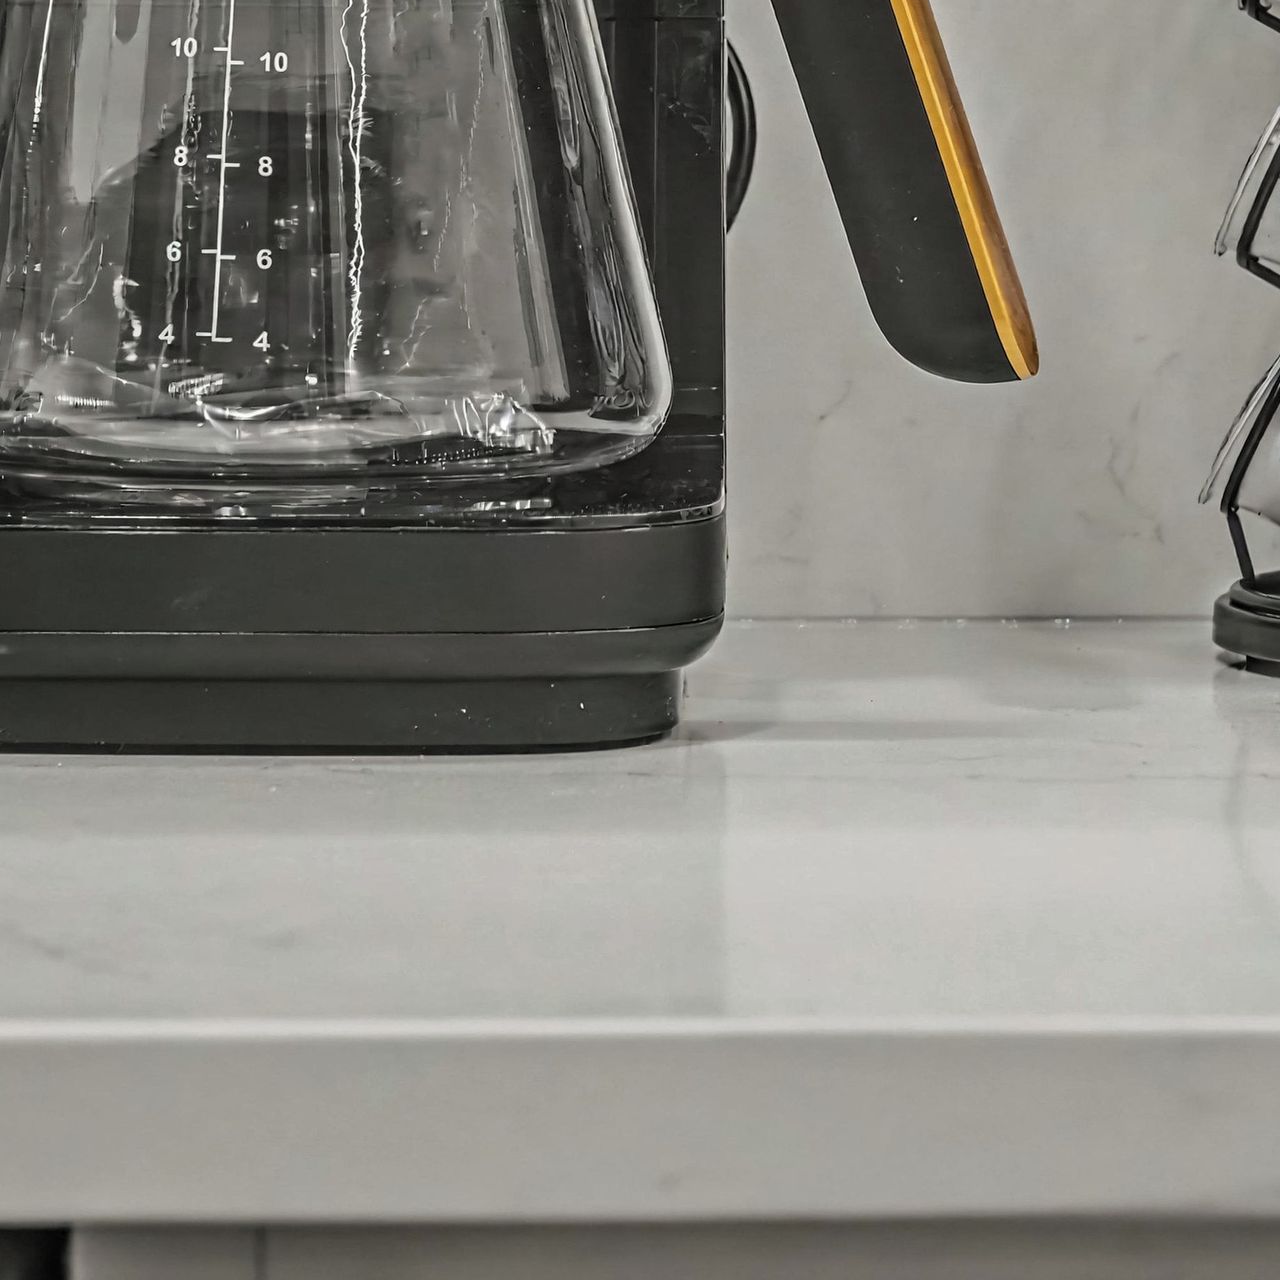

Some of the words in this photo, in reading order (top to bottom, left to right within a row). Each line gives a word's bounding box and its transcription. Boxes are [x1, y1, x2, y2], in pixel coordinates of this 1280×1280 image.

[170, 37, 198, 58] 10
[259, 52, 288, 73] 10
[173, 145, 189, 167] 8
[257, 155, 274, 177] 8
[166, 240, 182, 263] 6
[256, 248, 273, 270] 6
[158, 323, 175, 345] 4
[252, 331, 270, 352] 4
